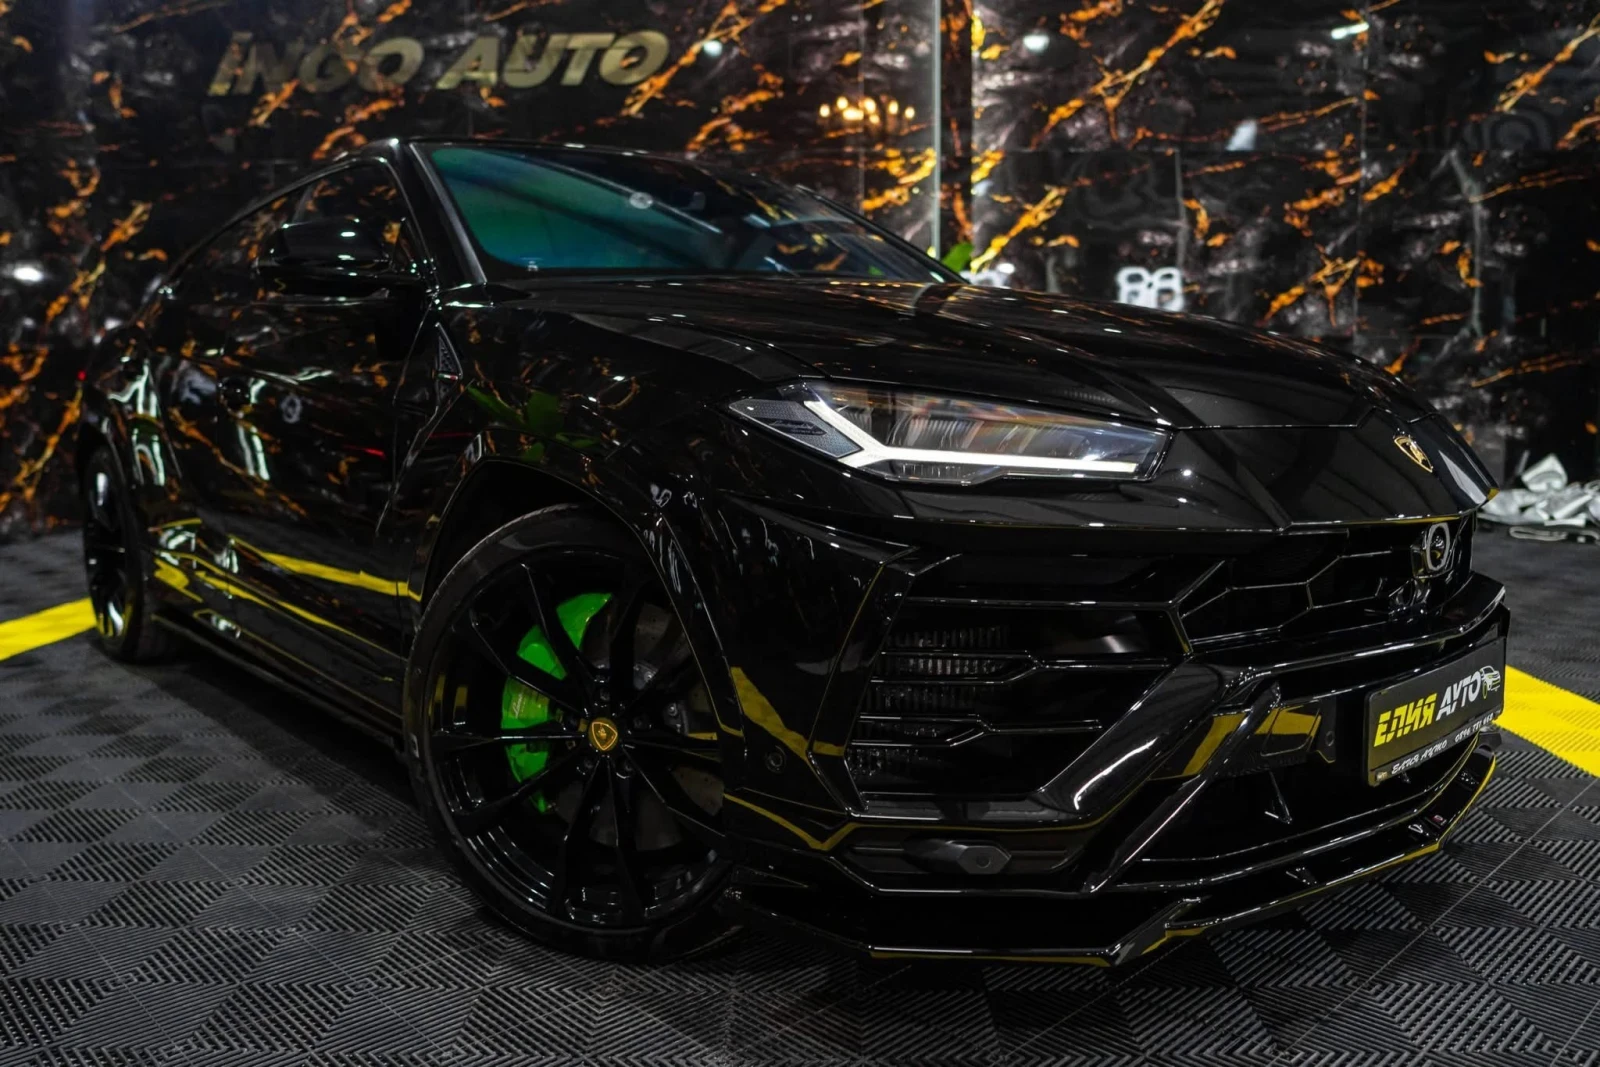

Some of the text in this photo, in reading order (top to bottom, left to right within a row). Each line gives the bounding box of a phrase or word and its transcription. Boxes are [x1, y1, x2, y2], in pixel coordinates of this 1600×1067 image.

[435, 29, 670, 91] AUTO
[1374, 671, 1482, 747] ЕЛИЯ АУТО
